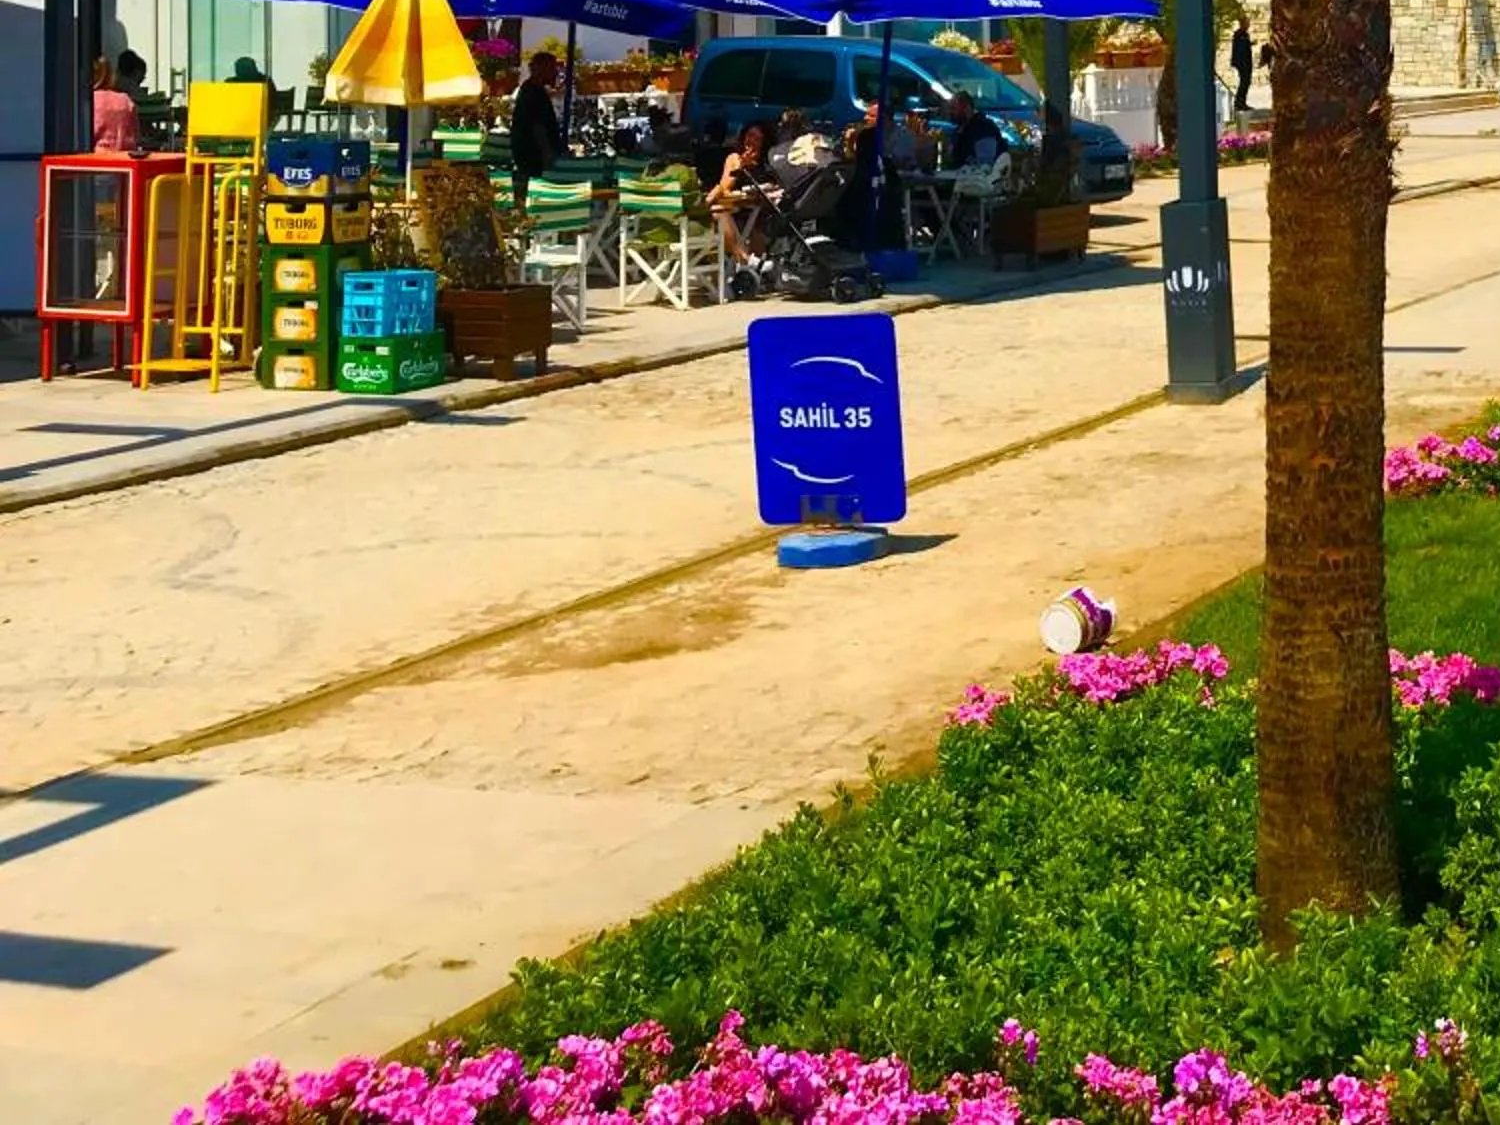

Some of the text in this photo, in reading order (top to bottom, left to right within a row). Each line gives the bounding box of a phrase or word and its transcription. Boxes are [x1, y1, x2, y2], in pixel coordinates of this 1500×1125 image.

[283, 166, 313, 180] EFES
[274, 217, 317, 230] TUBORG
[779, 402, 873, 428] SAHİL 35
